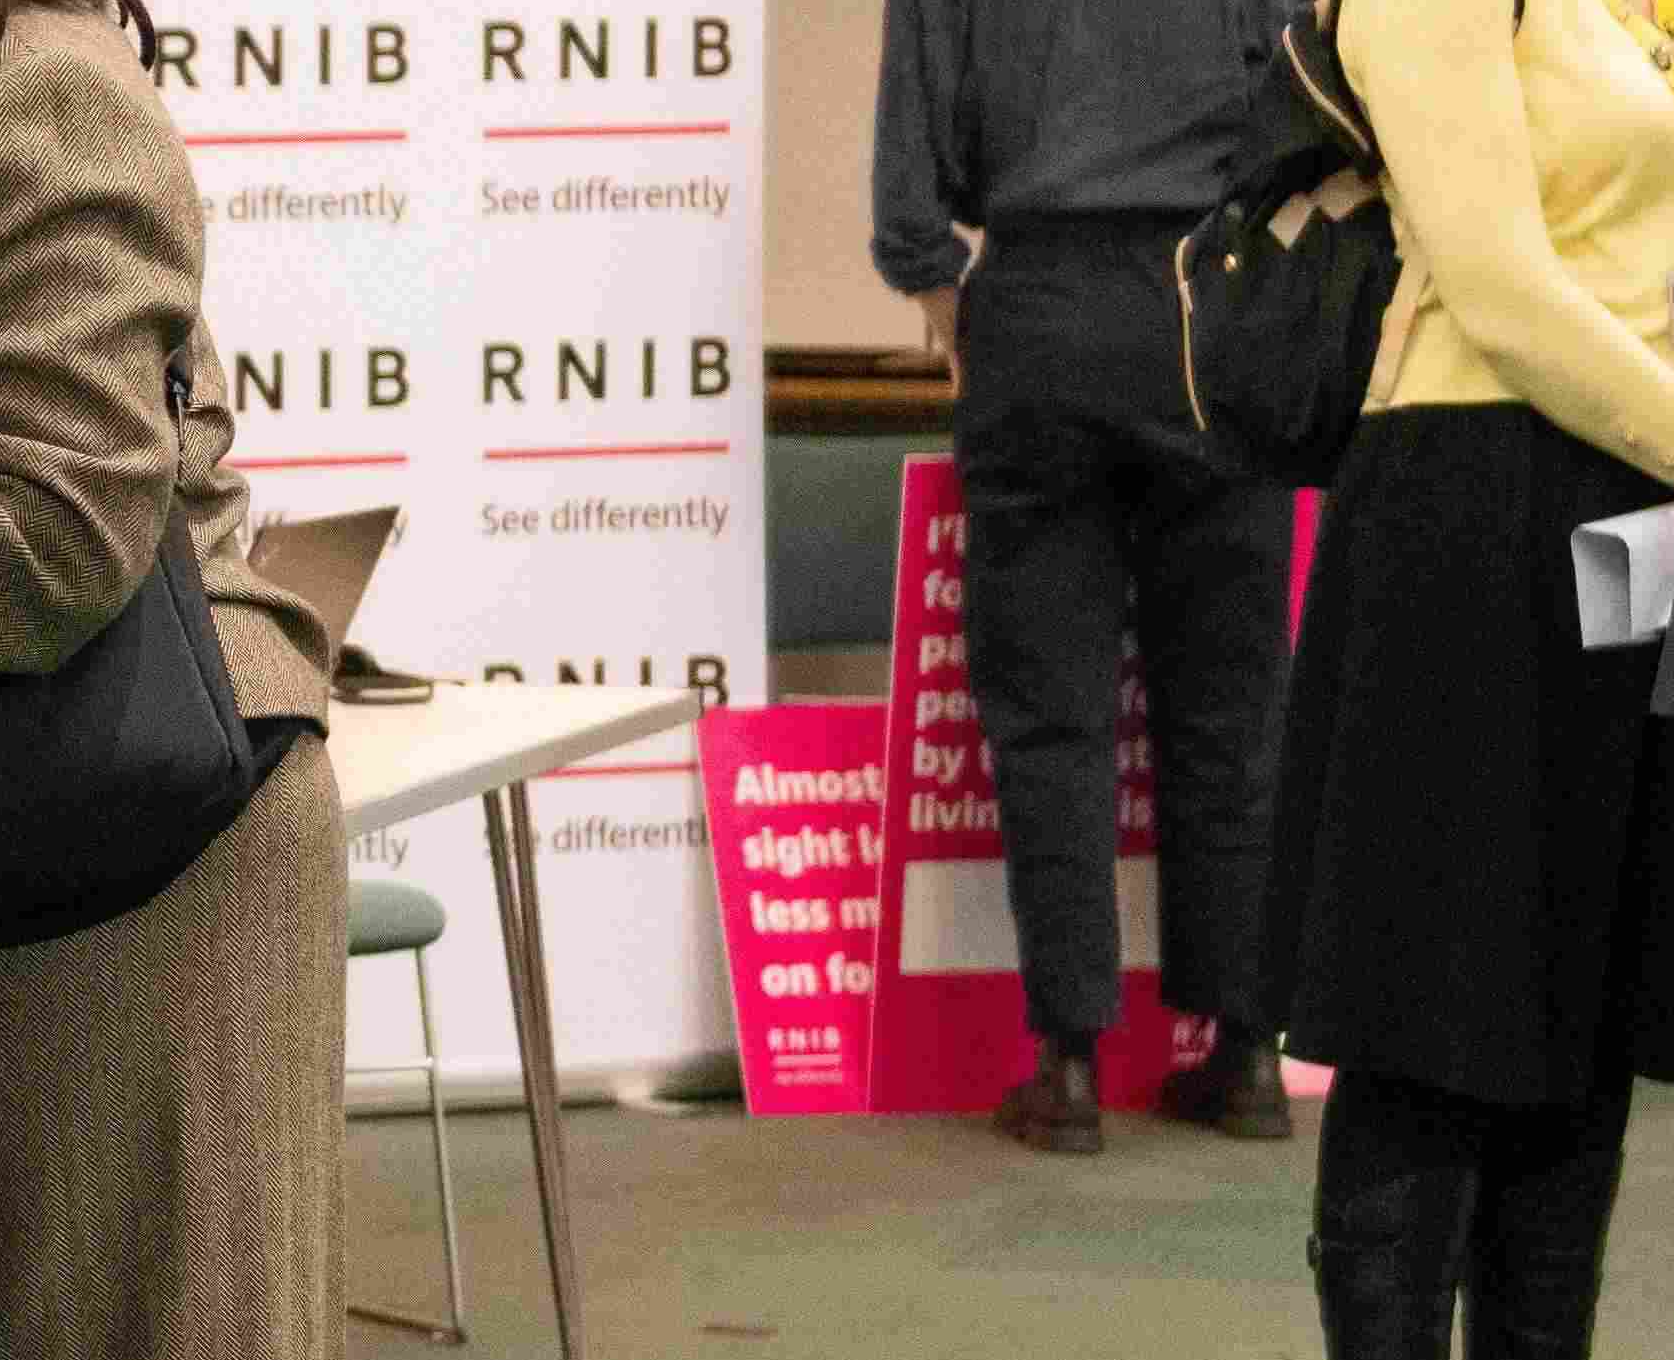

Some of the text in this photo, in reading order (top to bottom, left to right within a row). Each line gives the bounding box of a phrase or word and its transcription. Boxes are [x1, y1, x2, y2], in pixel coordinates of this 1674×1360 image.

[153, 22, 411, 90] RNIB
[481, 17, 733, 82] RNIB
[227, 182, 408, 225] differently
[481, 177, 731, 222] See differently
[235, 345, 411, 411] NIB
[481, 337, 732, 405] RNIB
[481, 495, 731, 540] See differently
[735, 762, 883, 806] Almost
[554, 816, 706, 854] differentl
[743, 823, 851, 878] sight
[761, 962, 819, 997] on
